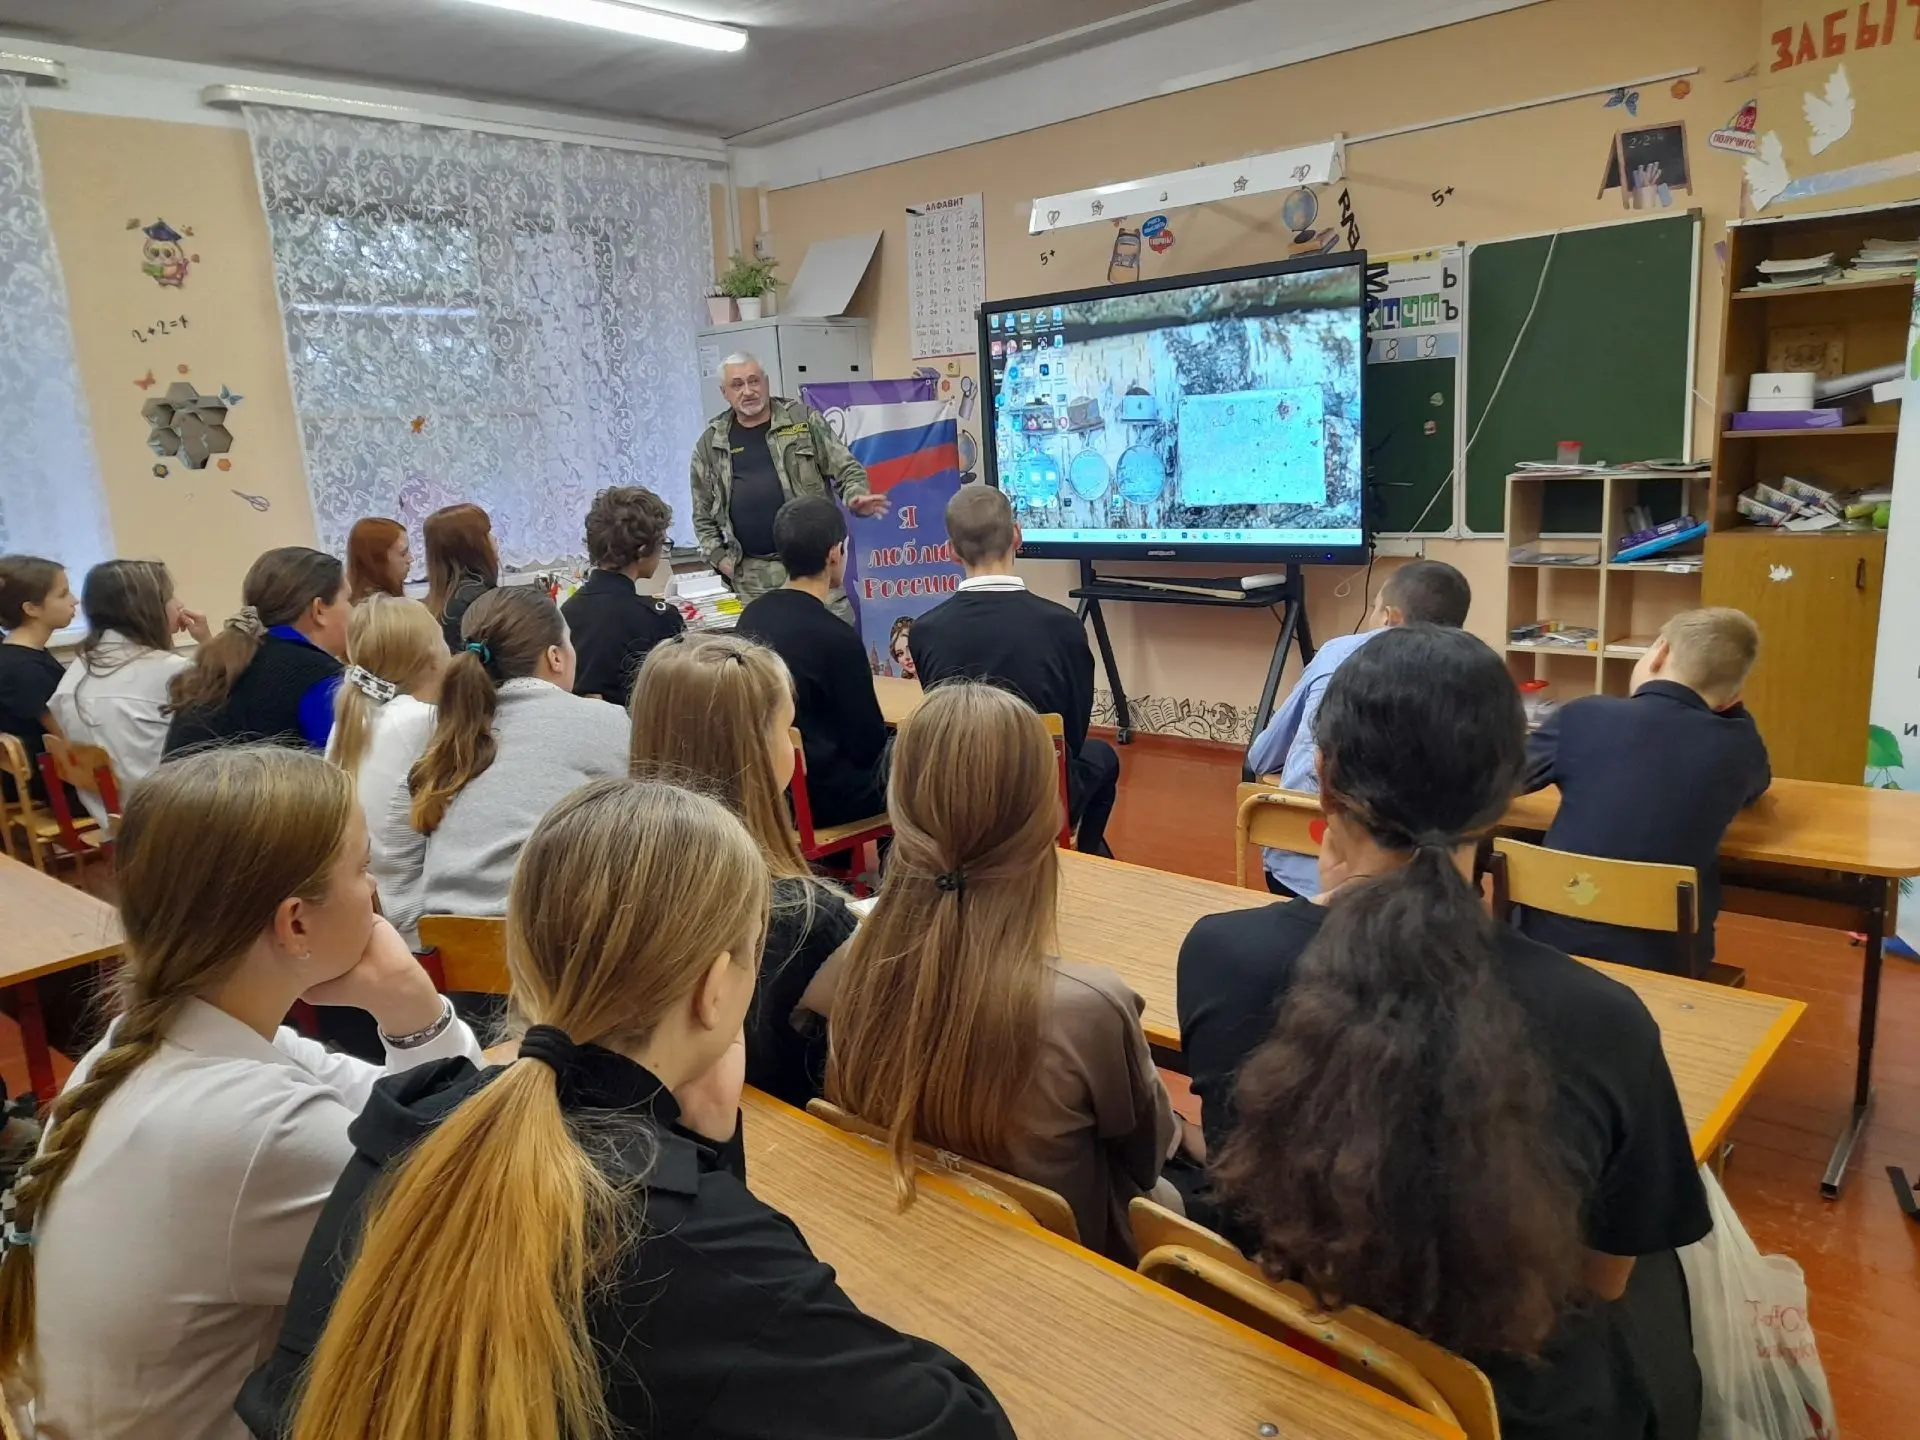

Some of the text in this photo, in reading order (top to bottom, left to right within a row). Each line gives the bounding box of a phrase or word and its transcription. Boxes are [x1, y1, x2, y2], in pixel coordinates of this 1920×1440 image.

[925, 197, 964, 212] АЛФАВИТ
[1431, 185, 1455, 207] 5+
[1040, 249, 1056, 266] 5+
[131, 314, 188, 343] 2+2=4
[1386, 335, 1437, 360] 8 9
[898, 506, 919, 529] Я
[864, 574, 962, 600] Россию
